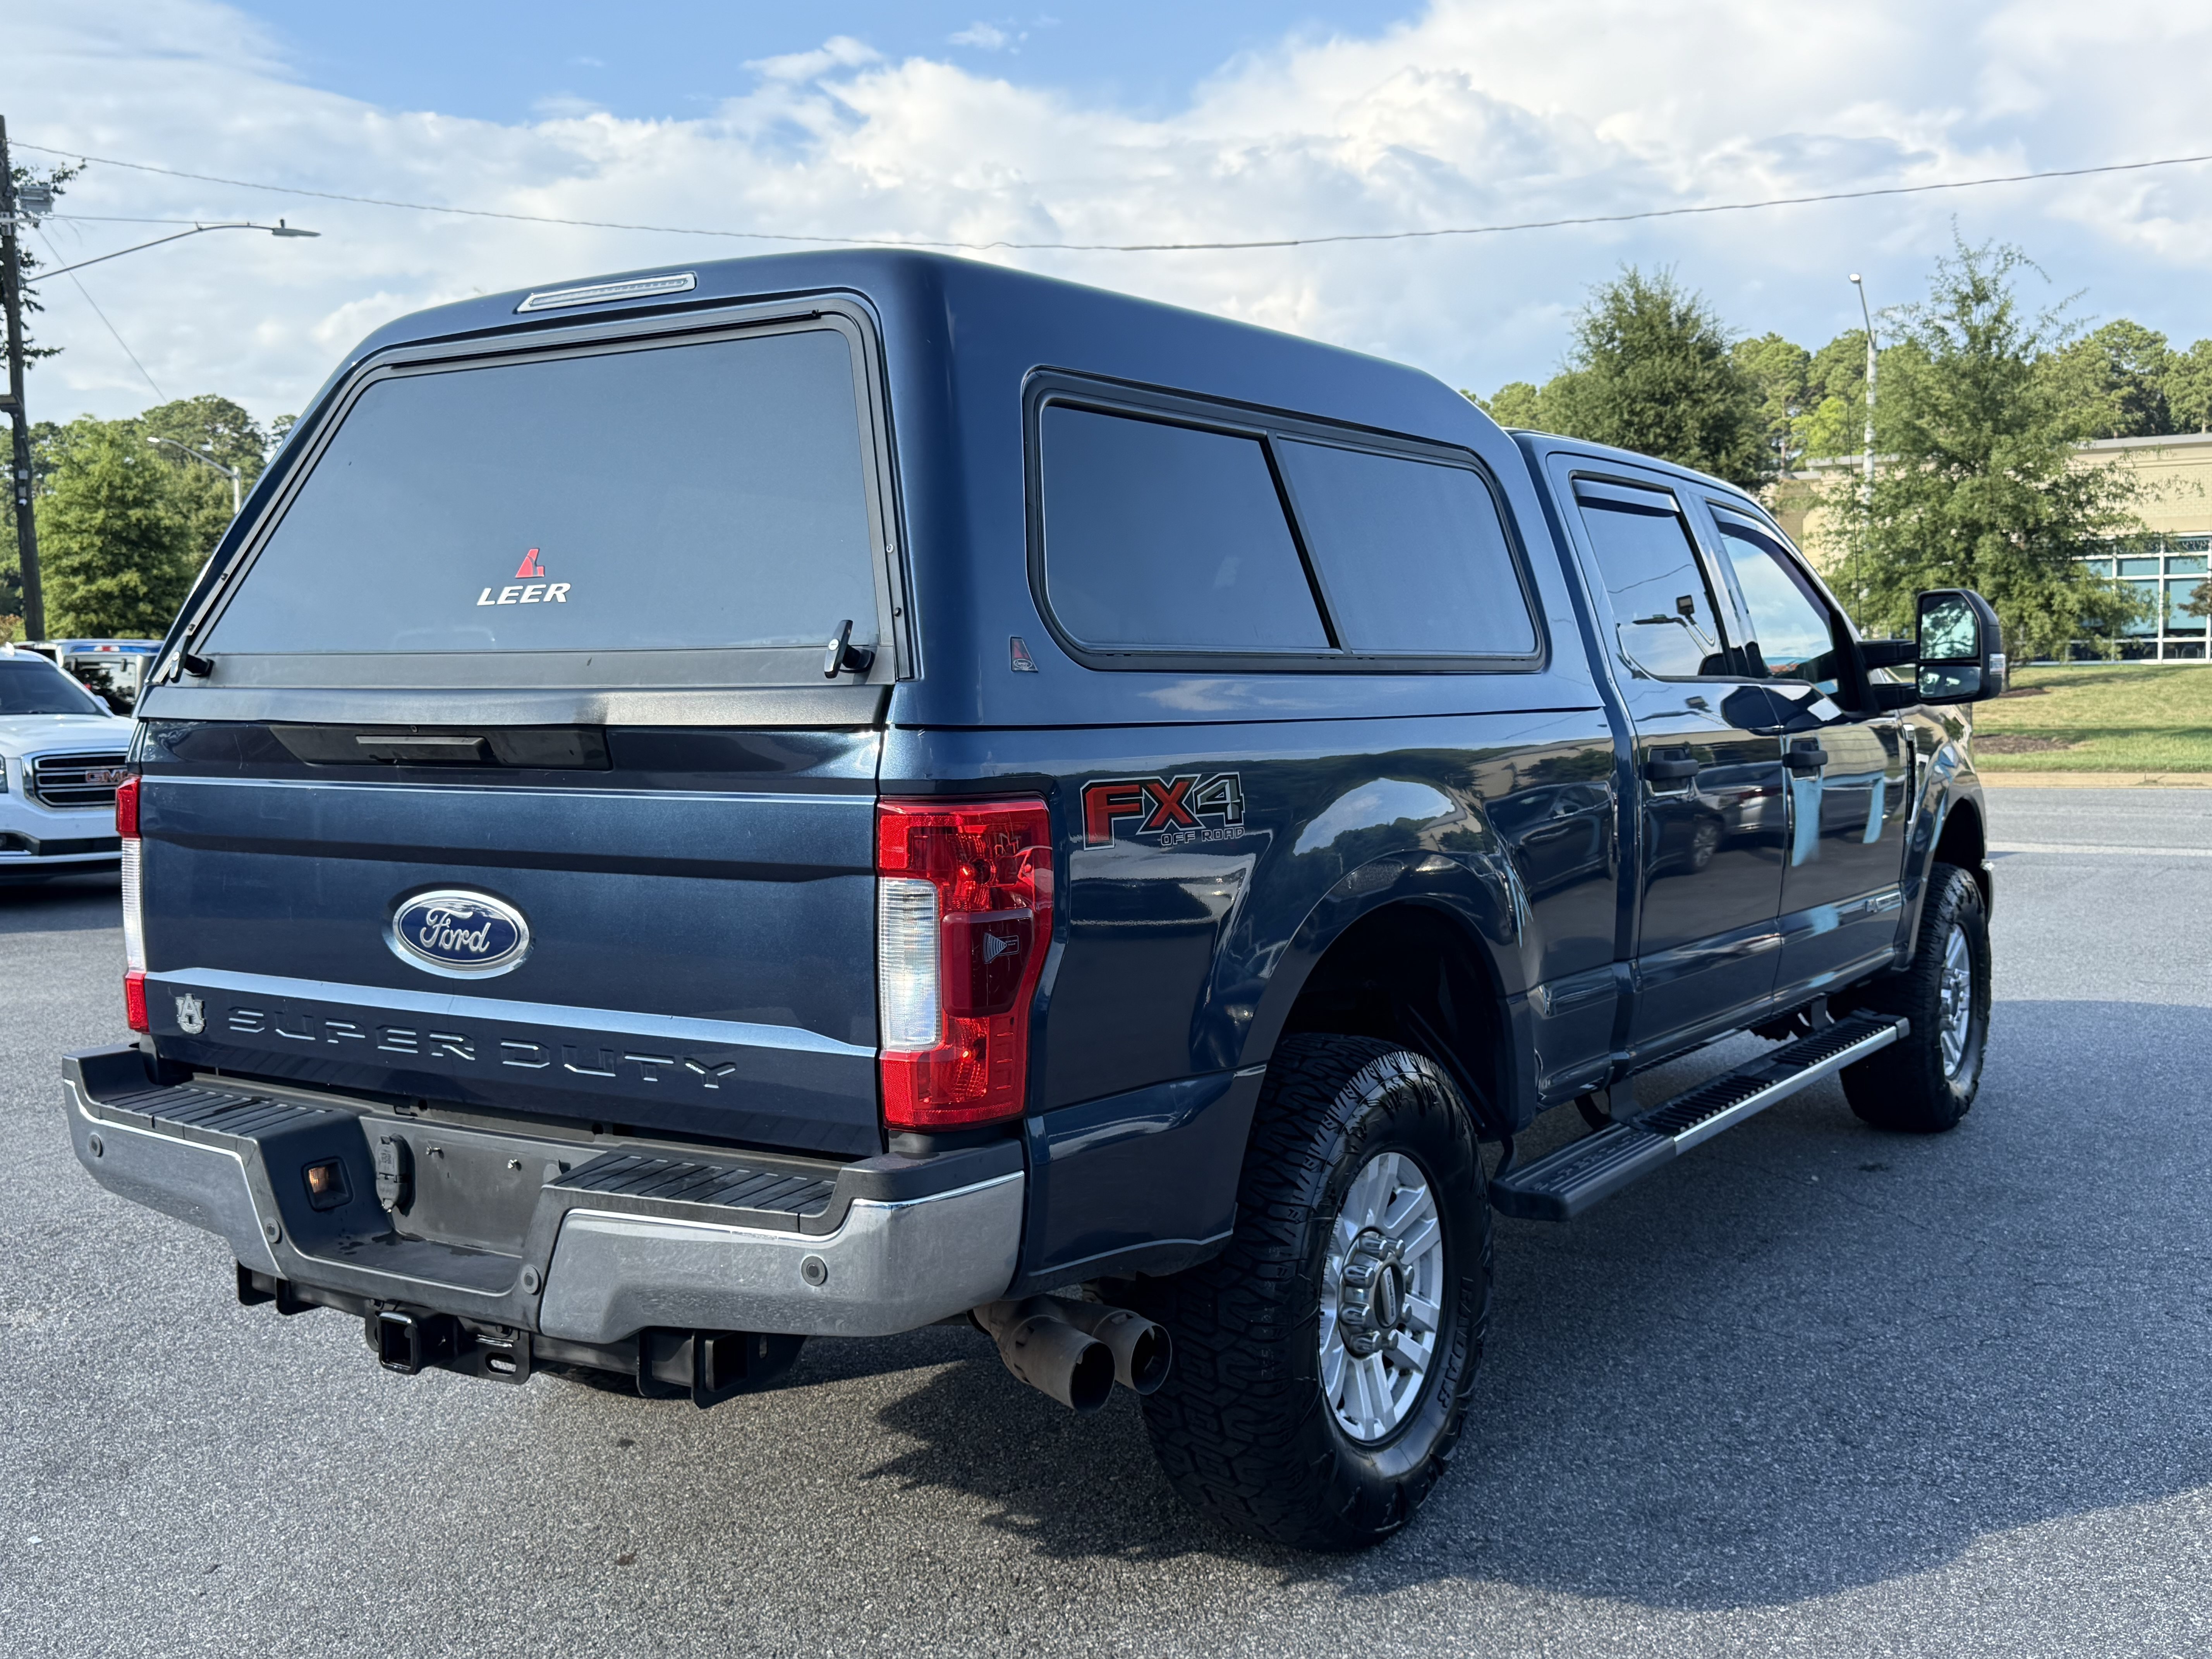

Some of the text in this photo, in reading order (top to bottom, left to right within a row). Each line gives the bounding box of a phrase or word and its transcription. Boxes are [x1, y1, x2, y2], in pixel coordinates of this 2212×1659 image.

[477, 582, 571, 606] LEER
[1080, 771, 1245, 851] FX4
[1161, 827, 1245, 847] OFF ROAD
[419, 907, 491, 953] Ford
[228, 1006, 736, 1089] SUPER DUTY
